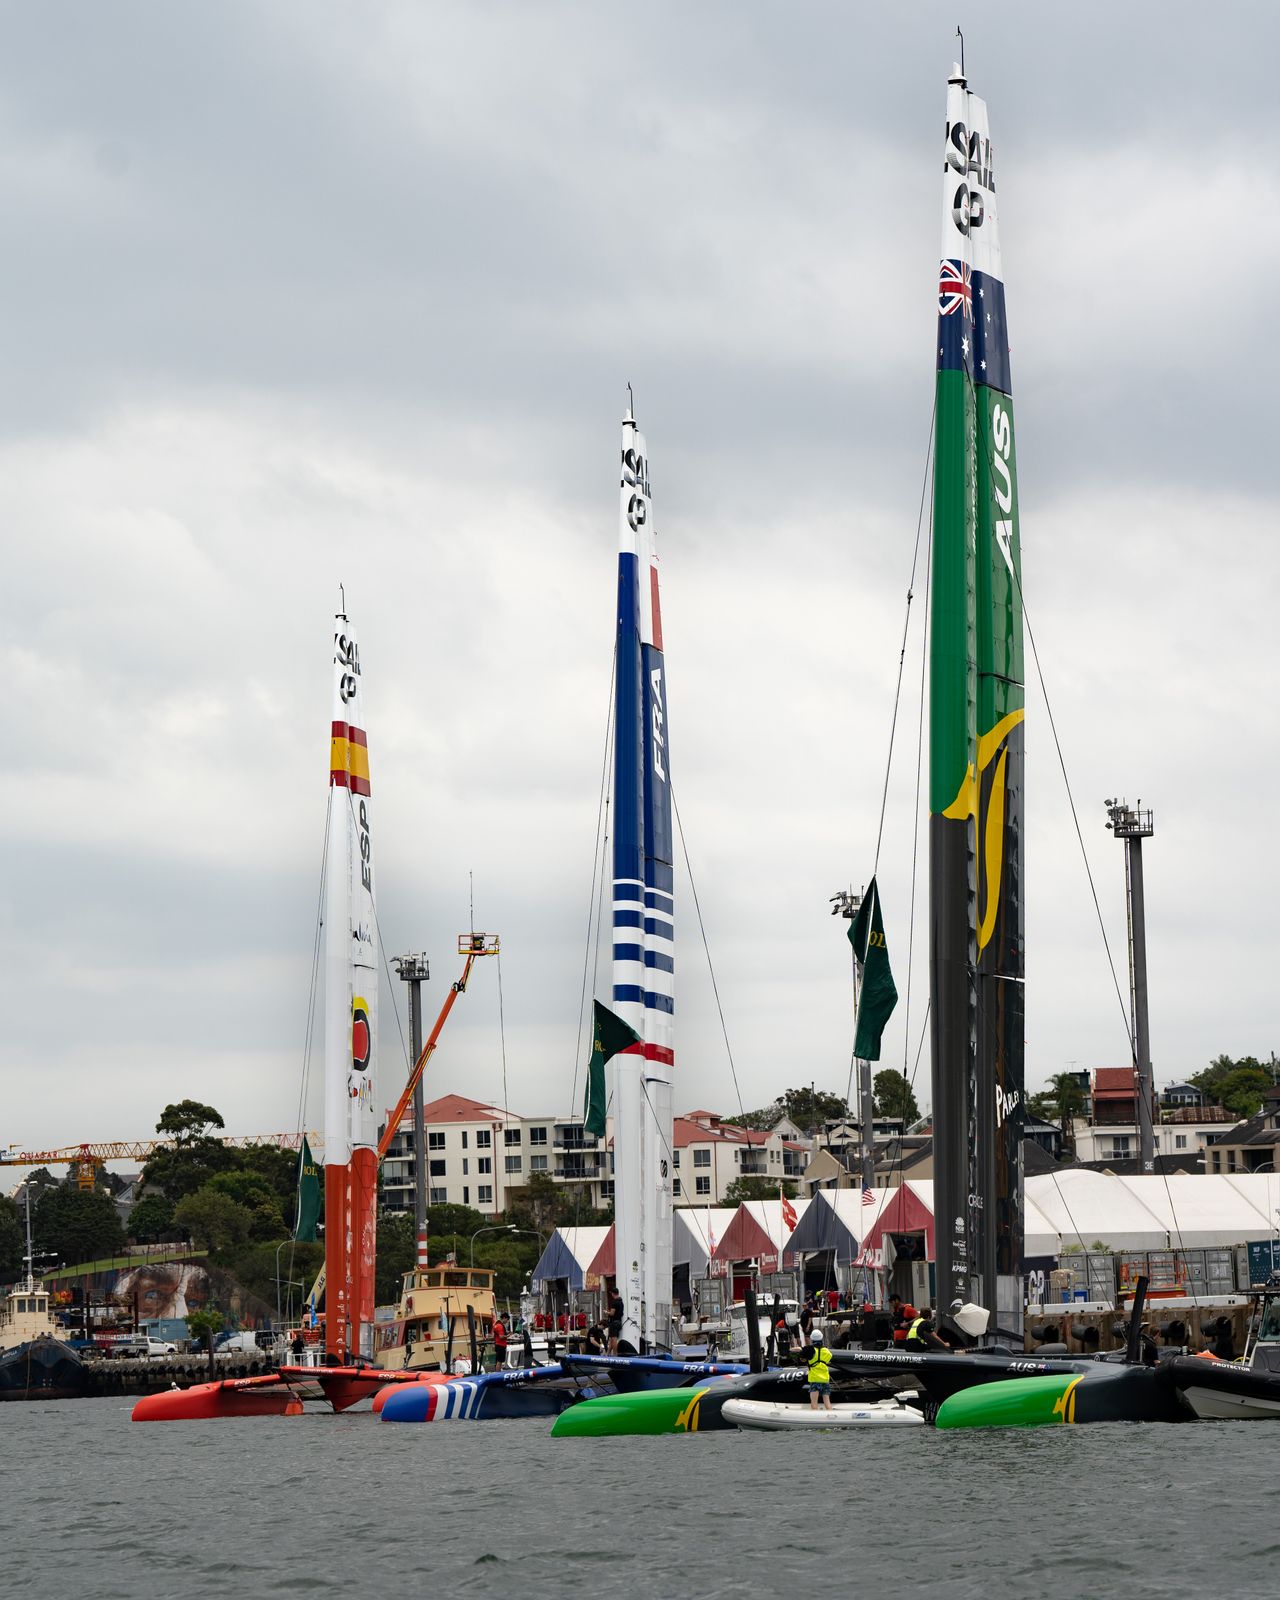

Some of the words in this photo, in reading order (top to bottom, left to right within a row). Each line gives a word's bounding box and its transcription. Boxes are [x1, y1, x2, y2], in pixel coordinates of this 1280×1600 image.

[992, 403, 1015, 579] AUS
[650, 668, 666, 783] FRA
[359, 799, 372, 894] ESP
[20, 1151, 58, 1160] QUASAR
[853, 1353, 886, 1362] POWERED
[886, 1354, 896, 1362] BY
[683, 1364, 705, 1373] FRA
[1007, 1361, 1036, 1373] AUS
[1211, 1361, 1251, 1372] PROTECTOR
[503, 1371, 525, 1381] FRA
[777, 1371, 804, 1383] AUS
